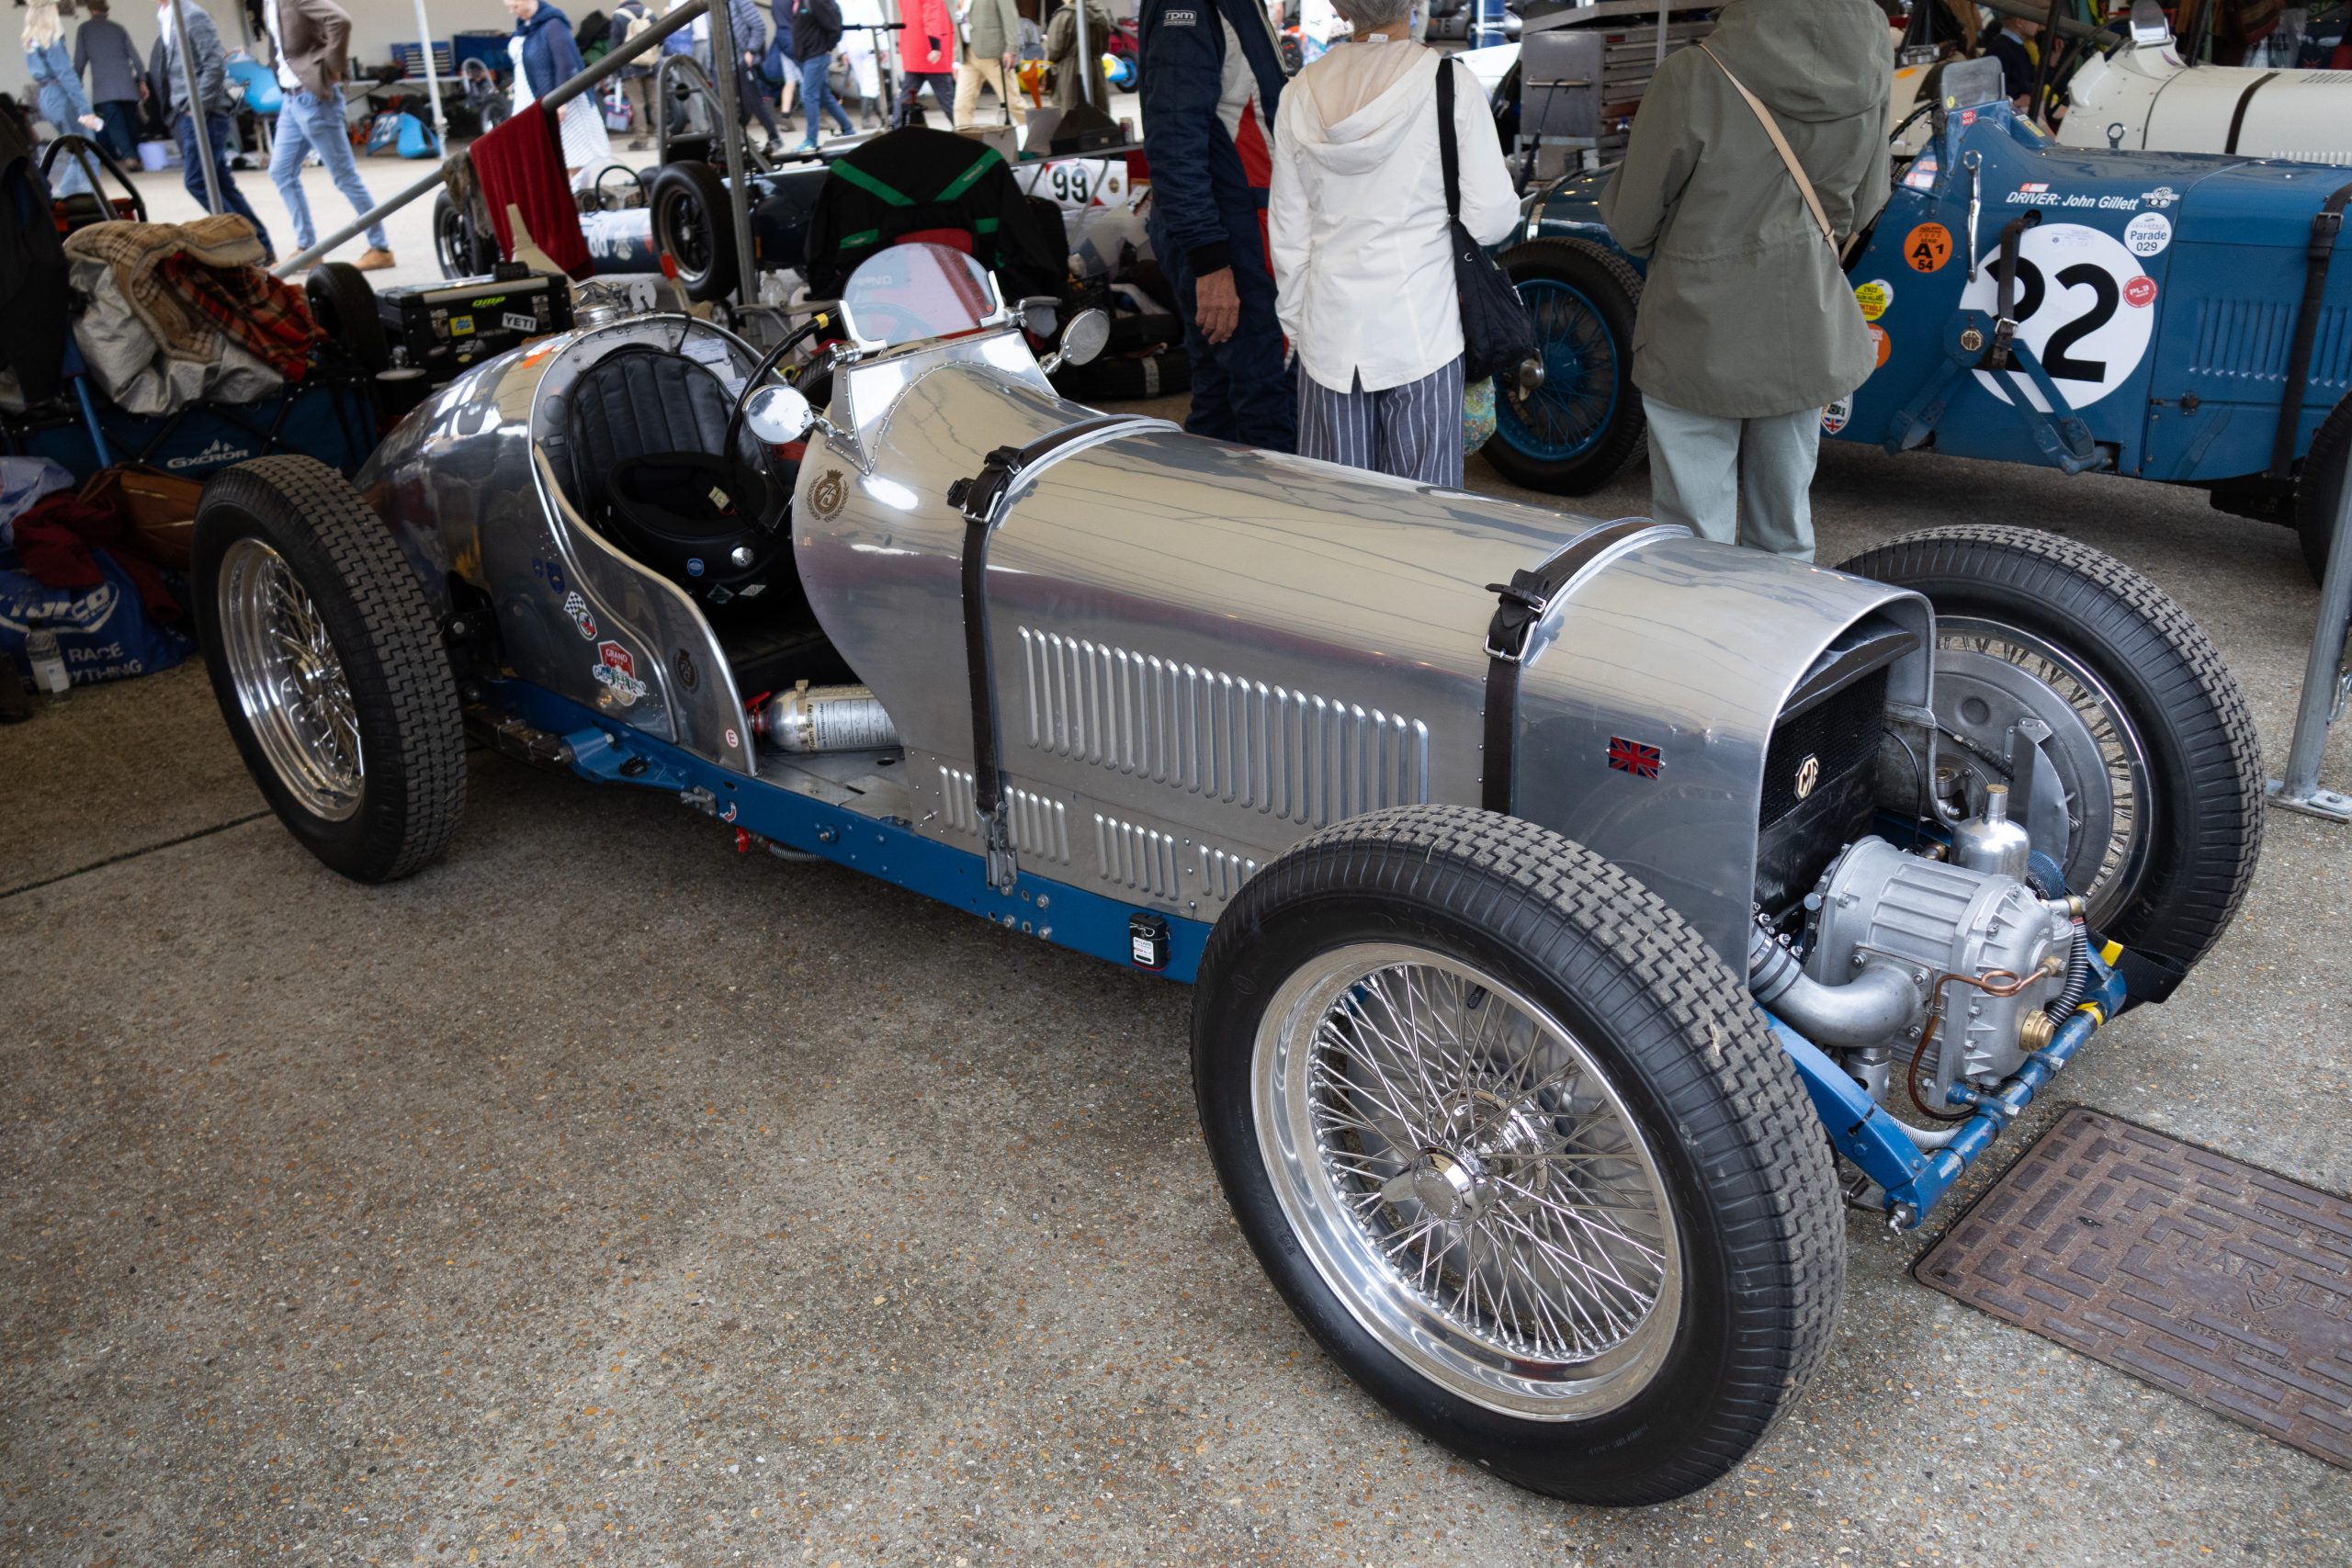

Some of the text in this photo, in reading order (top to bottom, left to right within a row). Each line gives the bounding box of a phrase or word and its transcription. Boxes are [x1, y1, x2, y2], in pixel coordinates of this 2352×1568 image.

[1052, 164, 1089, 204] 99
[2006, 191, 2140, 211] DRIVER: John Gillett
[2130, 231, 2167, 241] Parade
[2136, 242, 2158, 252] 029
[1917, 259, 1934, 271] 54
[505, 315, 535, 330] YETI
[68, 640, 125, 663] RACE
[605, 648, 628, 664] GRAND
[806, 704, 817, 751] Foam Spray
[1801, 761, 1819, 796] MG
[2176, 1238, 2352, 1321] HARTLI
